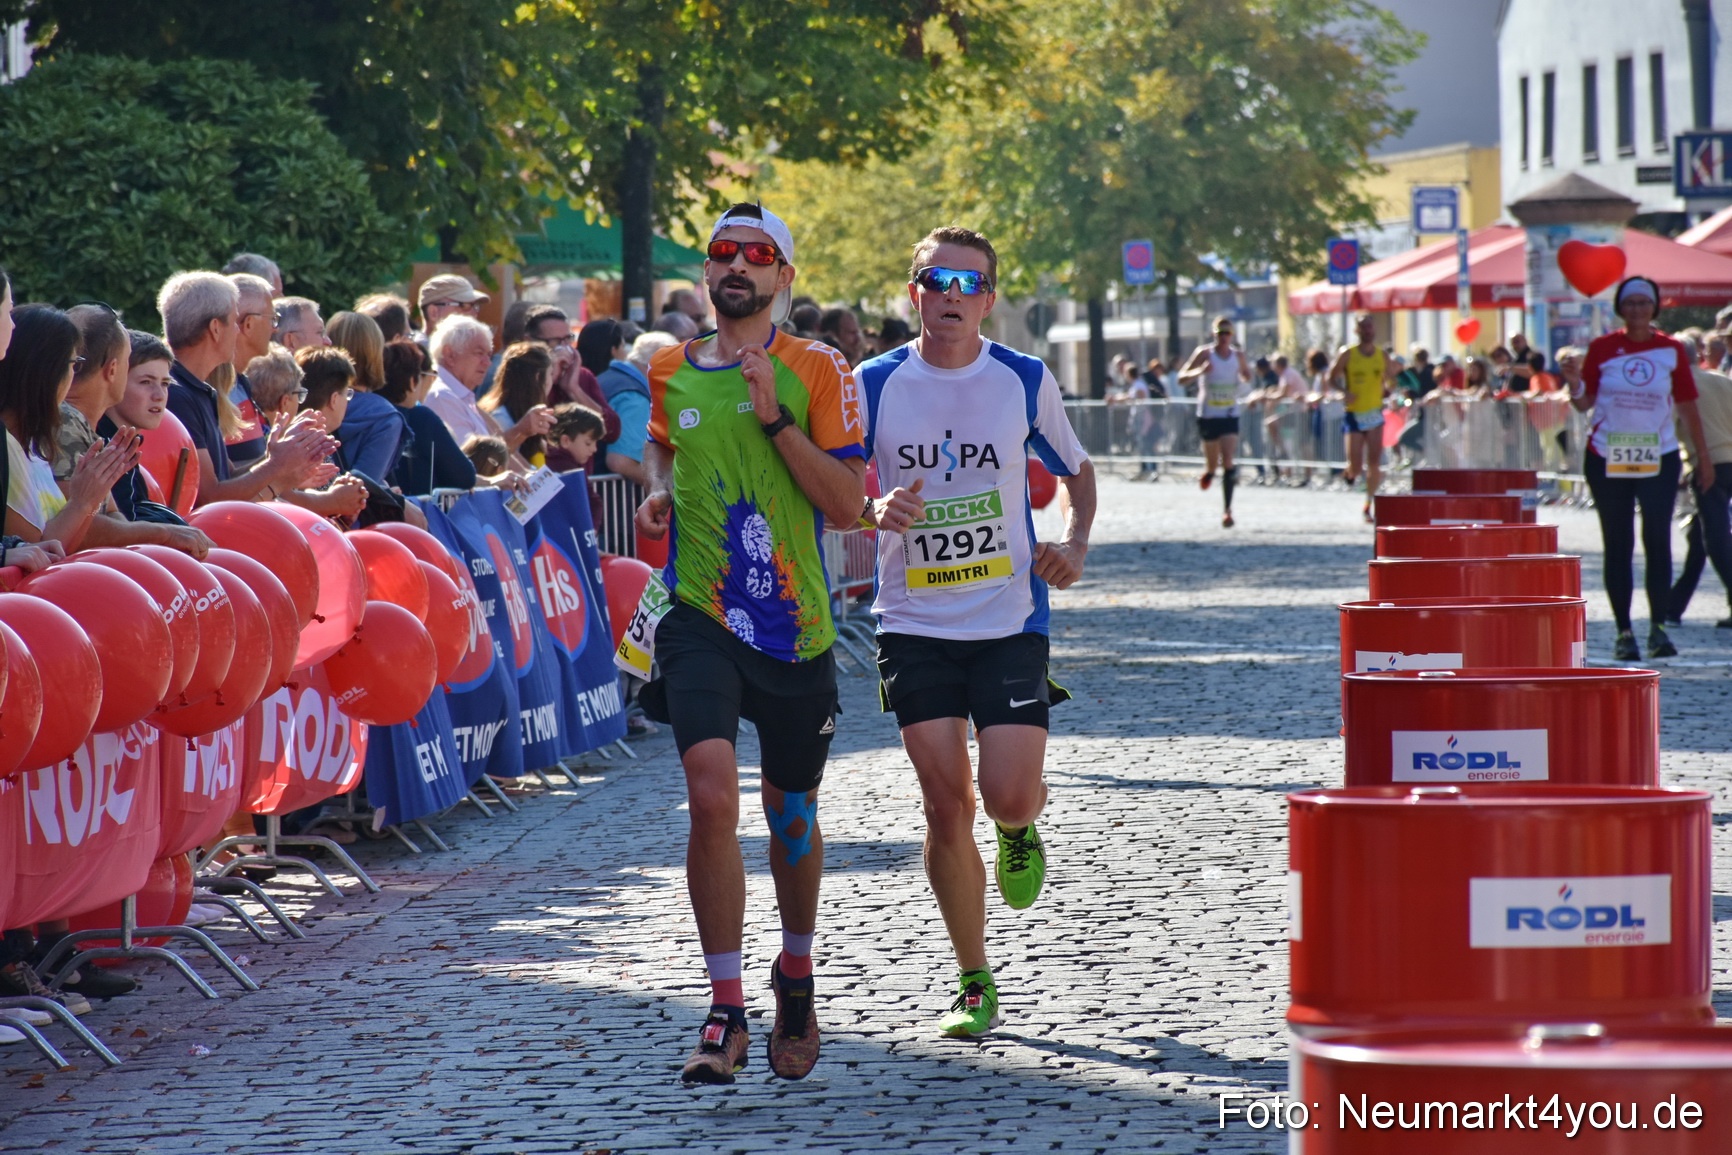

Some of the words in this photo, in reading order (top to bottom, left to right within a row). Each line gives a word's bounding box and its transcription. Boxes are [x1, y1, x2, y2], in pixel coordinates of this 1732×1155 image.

[898, 440, 1000, 471] SUSPA
[1613, 448, 1653, 462] 5124
[915, 494, 996, 525] OCK
[914, 526, 997, 562] 1292
[927, 564, 989, 584] DIMITRI
[619, 642, 630, 661] EL
[1467, 766, 1521, 780] energie
[1585, 924, 1645, 944] energie
